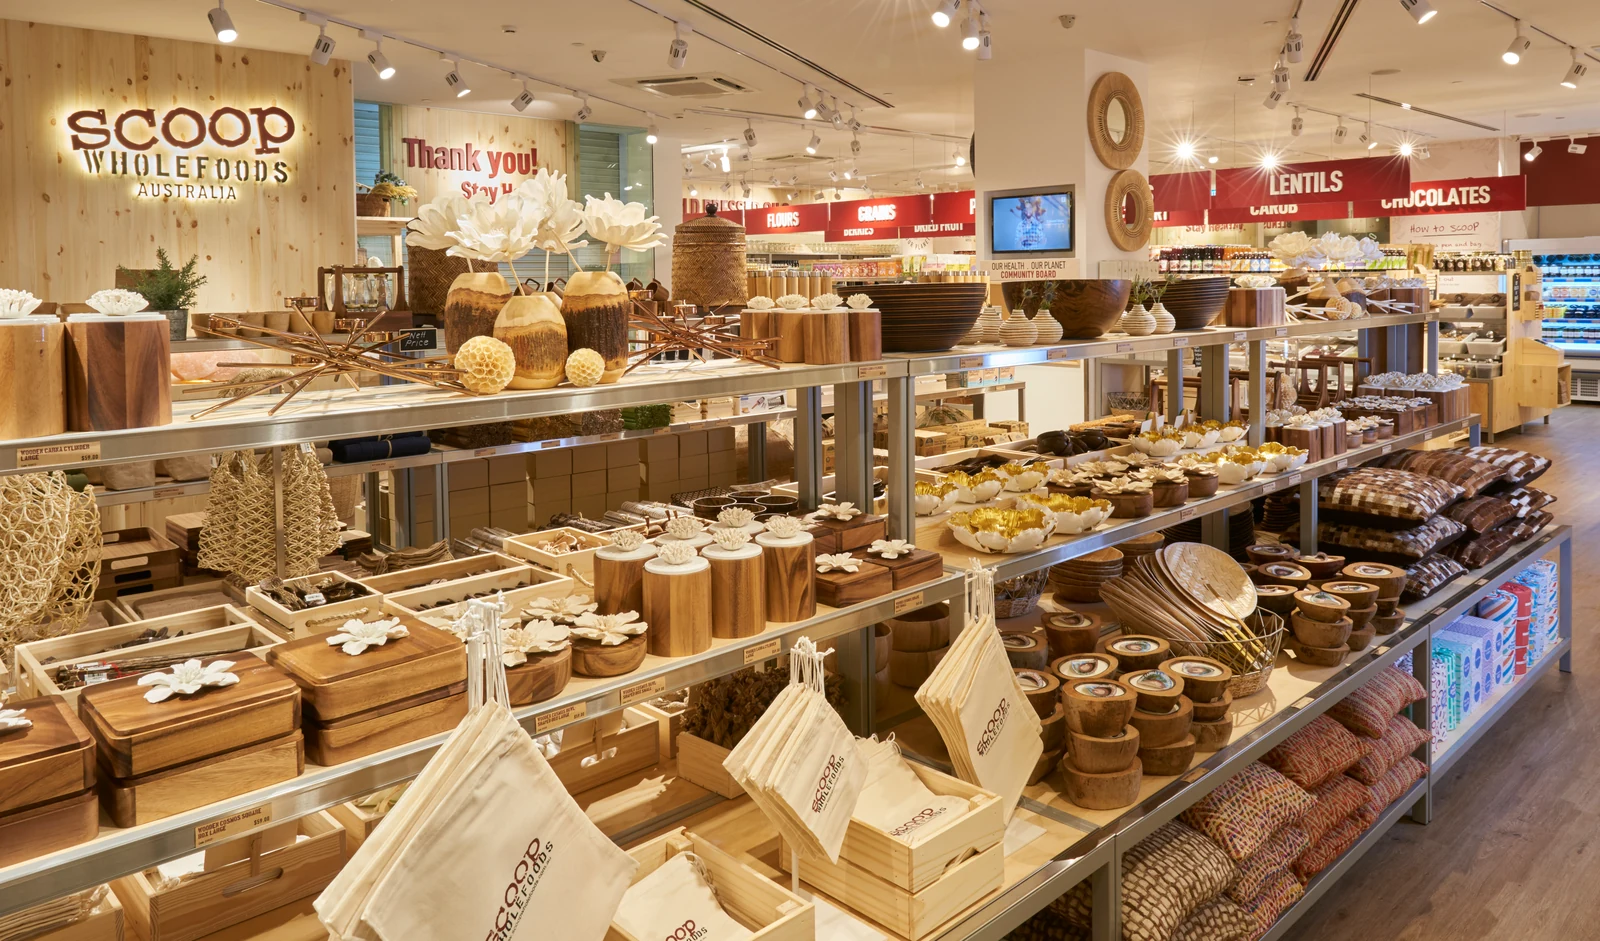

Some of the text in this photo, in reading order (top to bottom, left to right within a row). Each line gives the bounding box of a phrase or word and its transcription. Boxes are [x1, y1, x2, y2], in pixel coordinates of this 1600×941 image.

[83, 150, 288, 183] WHOLEFOODS
[402, 137, 538, 179] Thank you!
[137, 182, 236, 200] AUSTRALIA
[1270, 170, 1343, 196] LENTILS
[461, 181, 498, 205] Stay
[1381, 185, 1491, 209] CHOCOLATES
[767, 212, 800, 228] FLOURS
[858, 204, 897, 222] GRAINS
[940, 223, 964, 232] FRUIT
[992, 261, 1066, 270] OUR HEALTH OUR PLANET
[1001, 270, 1056, 279] COMMUNITY BOARD
[63, 444, 90, 452] CYLINDER
[197, 807, 262, 833] WOODEN COSMOS SQUARE
[209, 825, 227, 836] LARGE
[498, 841, 553, 941] HOLEFOODS
